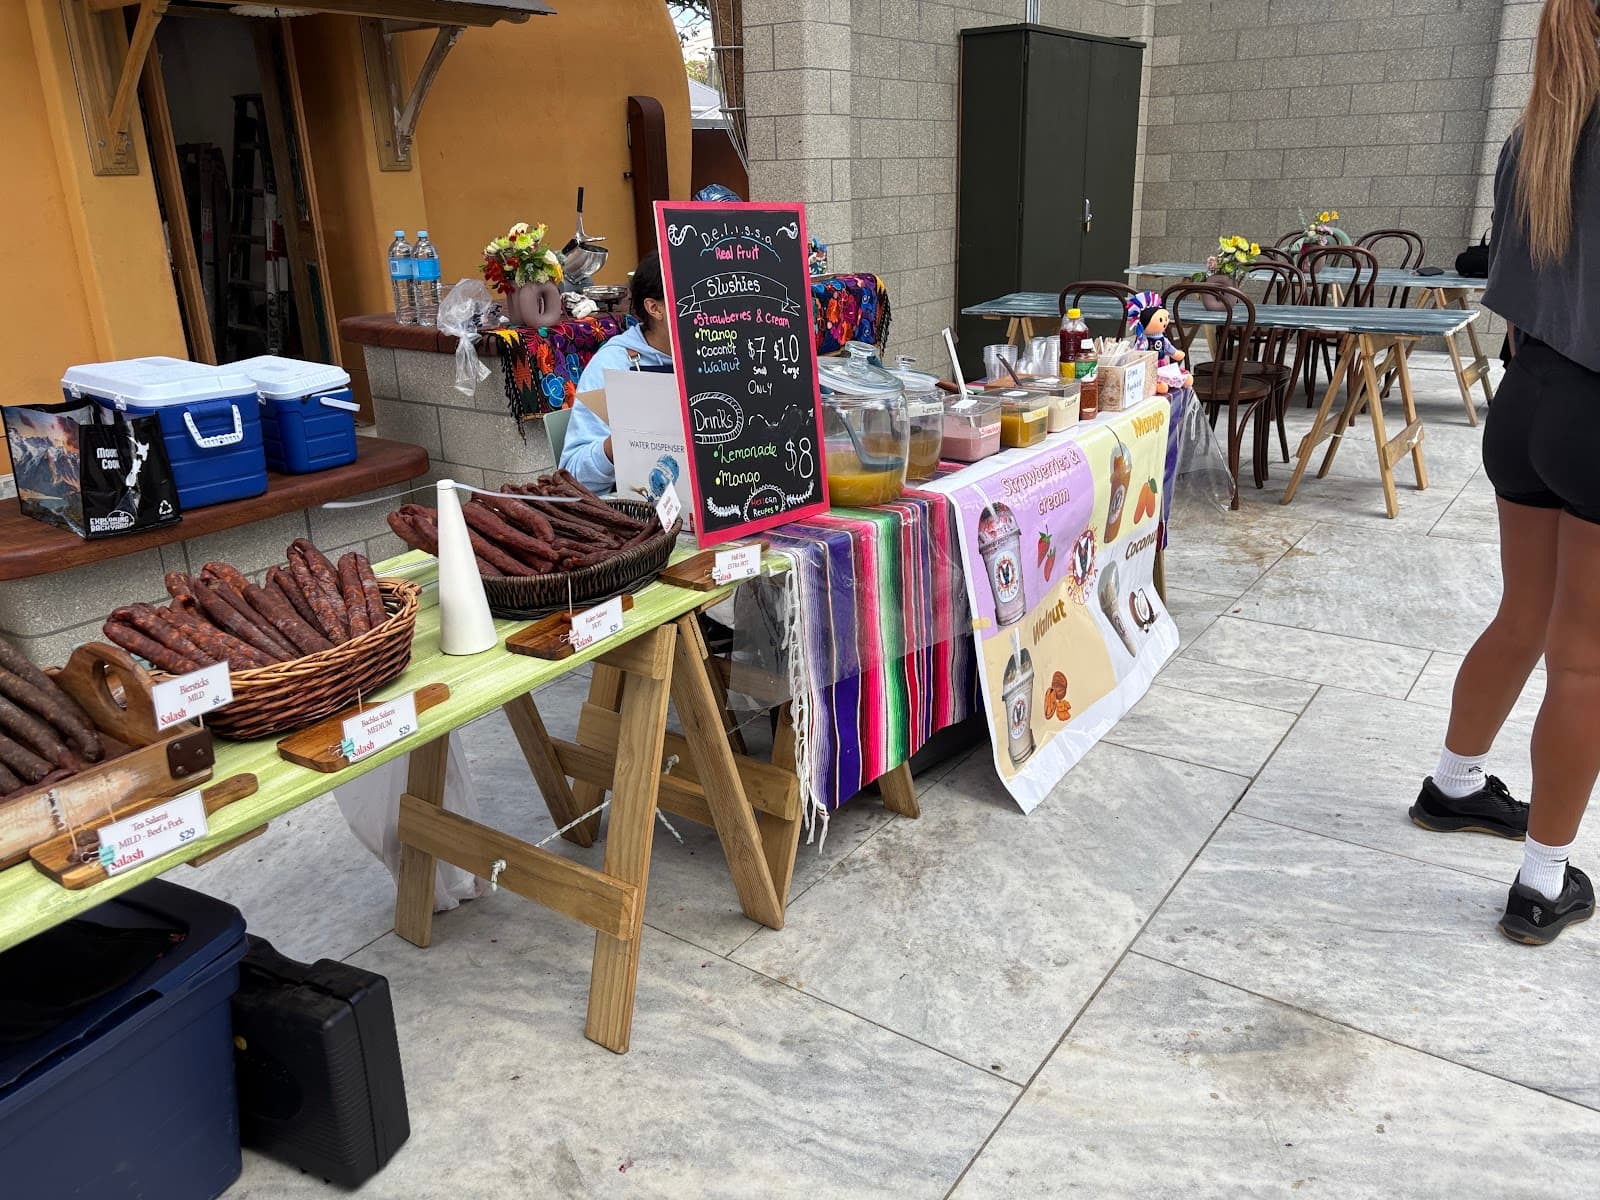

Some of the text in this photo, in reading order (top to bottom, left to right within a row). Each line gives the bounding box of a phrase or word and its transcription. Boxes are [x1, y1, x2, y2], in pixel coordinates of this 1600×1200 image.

[715, 244, 734, 260] Real
[706, 274, 761, 297] Slushies
[756, 308, 763, 323] &
[748, 334, 800, 364] $7 $10
[1131, 411, 1165, 439] Mango
[629, 440, 685, 453] WATER DISPENSER
[718, 442, 778, 464] Lemonade
[785, 437, 814, 479] $8
[1001, 447, 1081, 496] Strawberries &
[1032, 598, 1067, 647] Walnut
[187, 691, 205, 703] MILD
[160, 708, 187, 726] Salash
[367, 719, 393, 736] MEDIUM
[399, 723, 411, 736] $29
[131, 812, 169, 832] Tea Salami
[118, 834, 142, 850] MILD
[147, 825, 163, 838] Beef
[167, 816, 185, 830] Pork
[178, 827, 196, 842] $29
